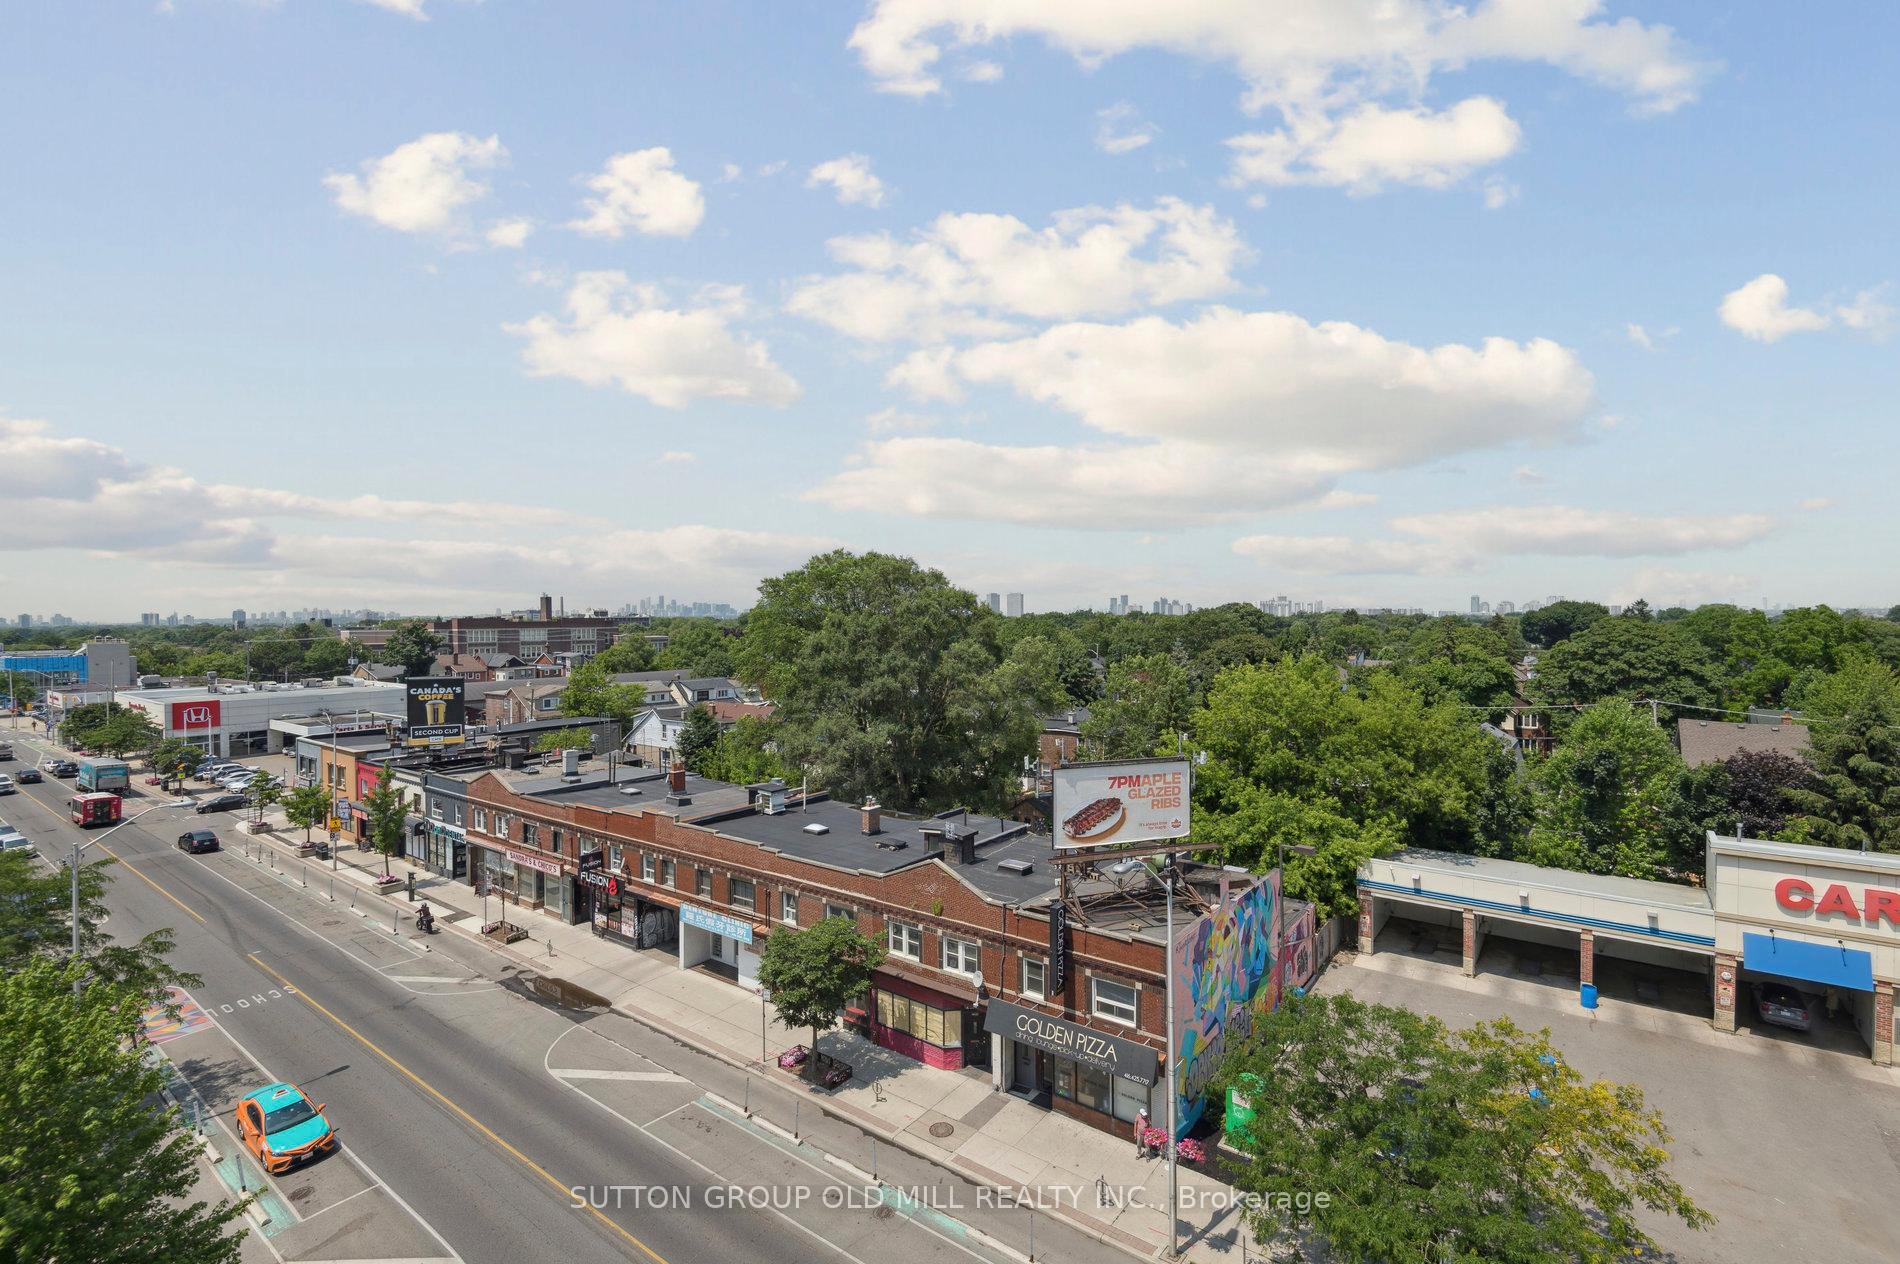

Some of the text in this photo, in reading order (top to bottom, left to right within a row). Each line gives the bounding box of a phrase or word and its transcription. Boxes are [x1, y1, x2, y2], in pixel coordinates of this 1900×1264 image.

[1107, 772, 1181, 789] 7PMAPLE
[1128, 786, 1181, 799] GLAZED
[1151, 797, 1181, 810] RIBS
[581, 871, 609, 888] FUSION
[1775, 878, 1900, 925] CAR
[206, 985, 297, 1017] SCHOOL
[1016, 1014, 1117, 1062] GOLDEN PIZZA
